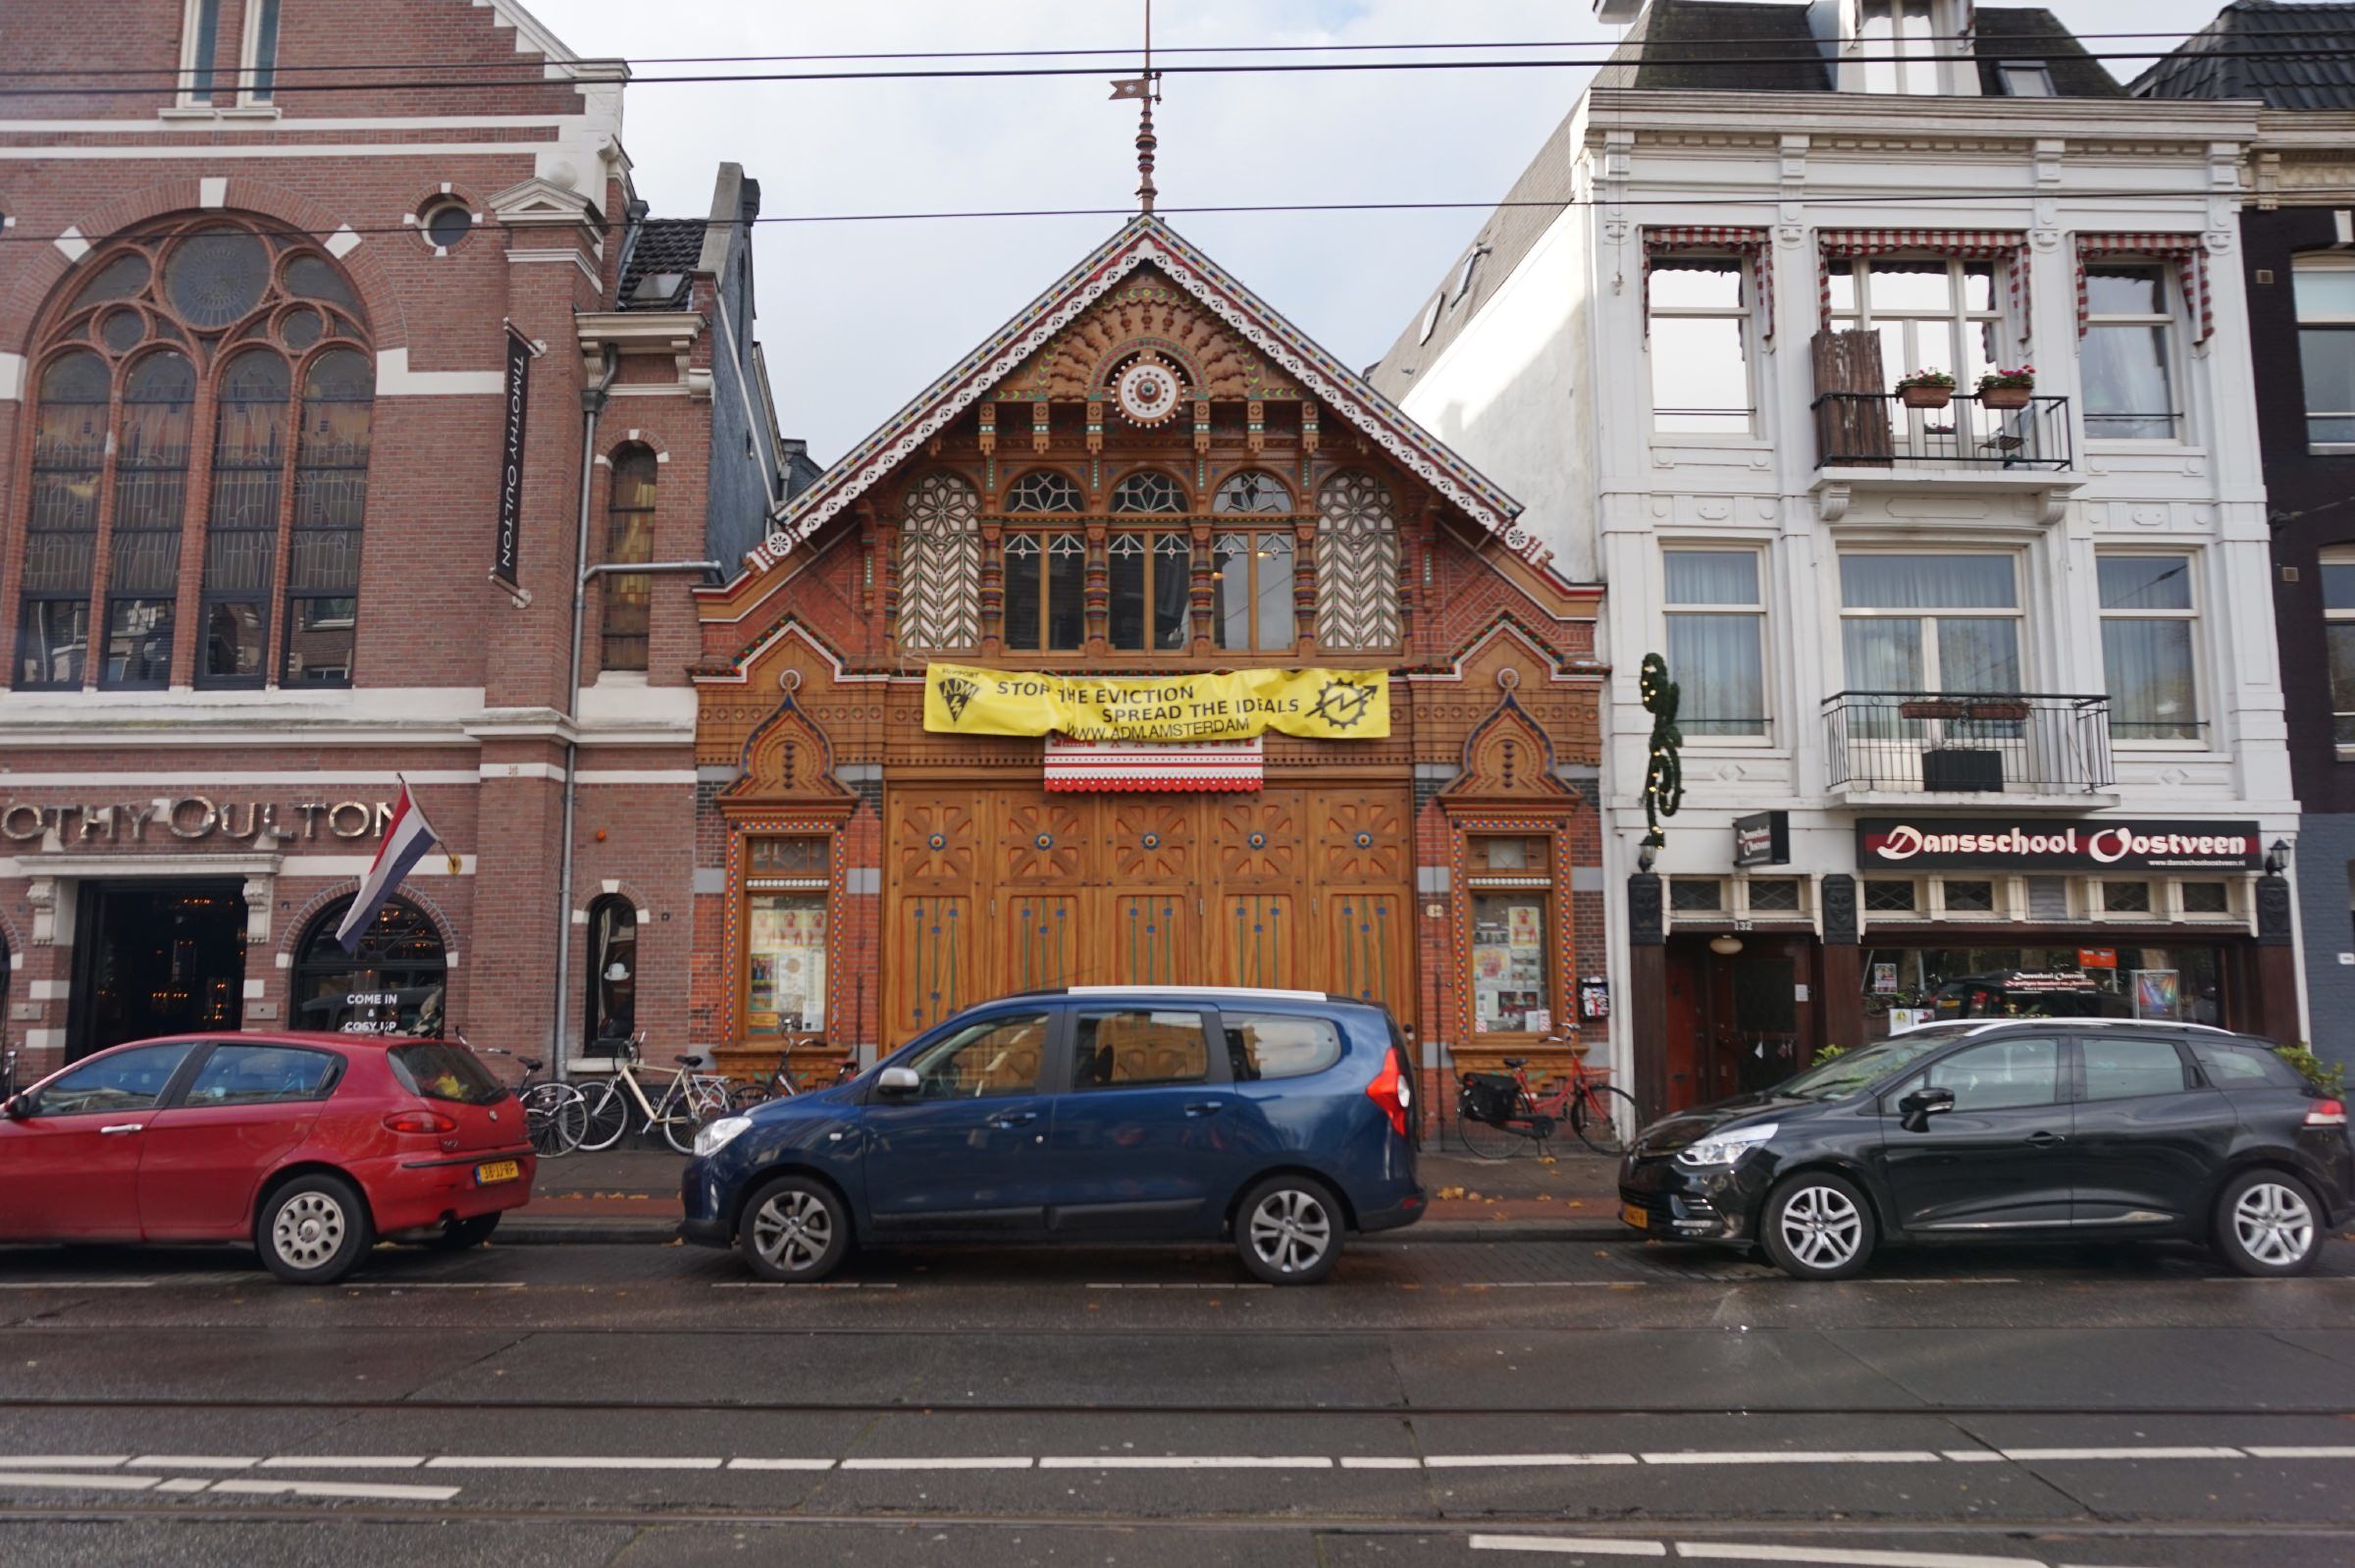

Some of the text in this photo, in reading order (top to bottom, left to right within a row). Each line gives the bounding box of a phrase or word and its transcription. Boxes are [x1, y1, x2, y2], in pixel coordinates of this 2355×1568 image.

[501, 356, 523, 566] TIMOTHY OULTON
[941, 678, 979, 699] ADM
[996, 680, 1194, 705] STOP THE EVICTION
[1101, 698, 1299, 724] SPREAD THE IDEALS
[1876, 824, 2247, 863] Dansschool Oostveen
[1734, 920, 1753, 931] 132
[346, 994, 397, 1005] COME IN
[344, 1021, 377, 1031] COSY
